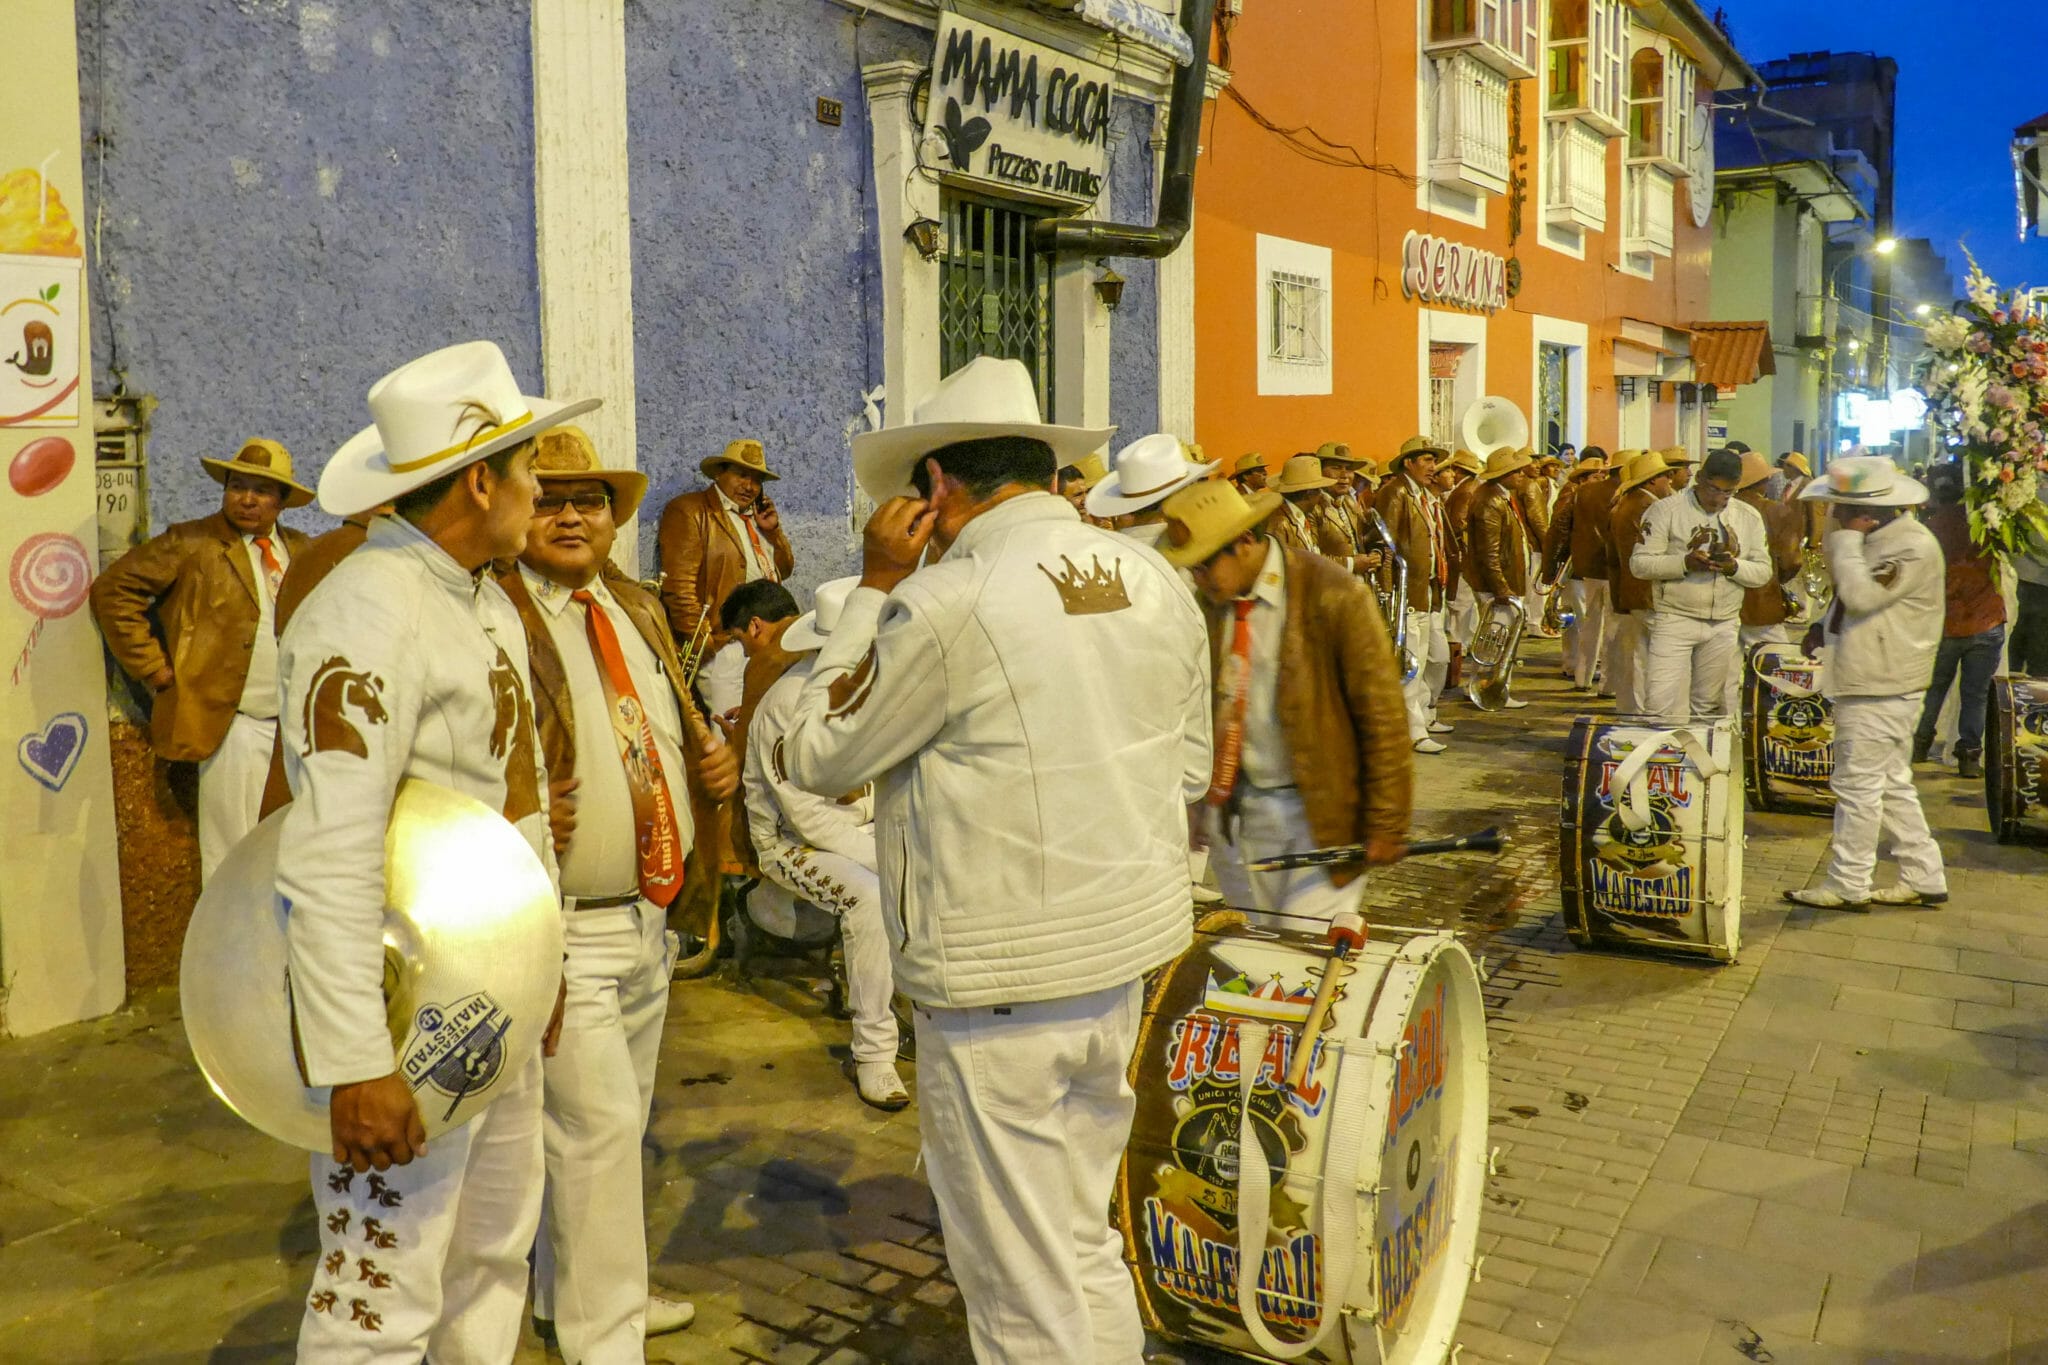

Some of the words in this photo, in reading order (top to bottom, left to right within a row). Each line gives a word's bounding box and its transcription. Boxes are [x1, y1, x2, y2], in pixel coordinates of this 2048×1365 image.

[941, 28, 1040, 128] MAMA
[1046, 67, 1110, 148] COCA
[988, 143, 1041, 184] Pizzas
[1043, 163, 1053, 187] &
[1055, 160, 1101, 197] Drinks
[1417, 237, 1506, 309] SERUNA
[1600, 763, 1690, 805] RAL
[1591, 858, 1693, 916] MAJESTAD
[405, 997, 488, 1075] MAJESTAD
[435, 1025, 470, 1057] REAL
